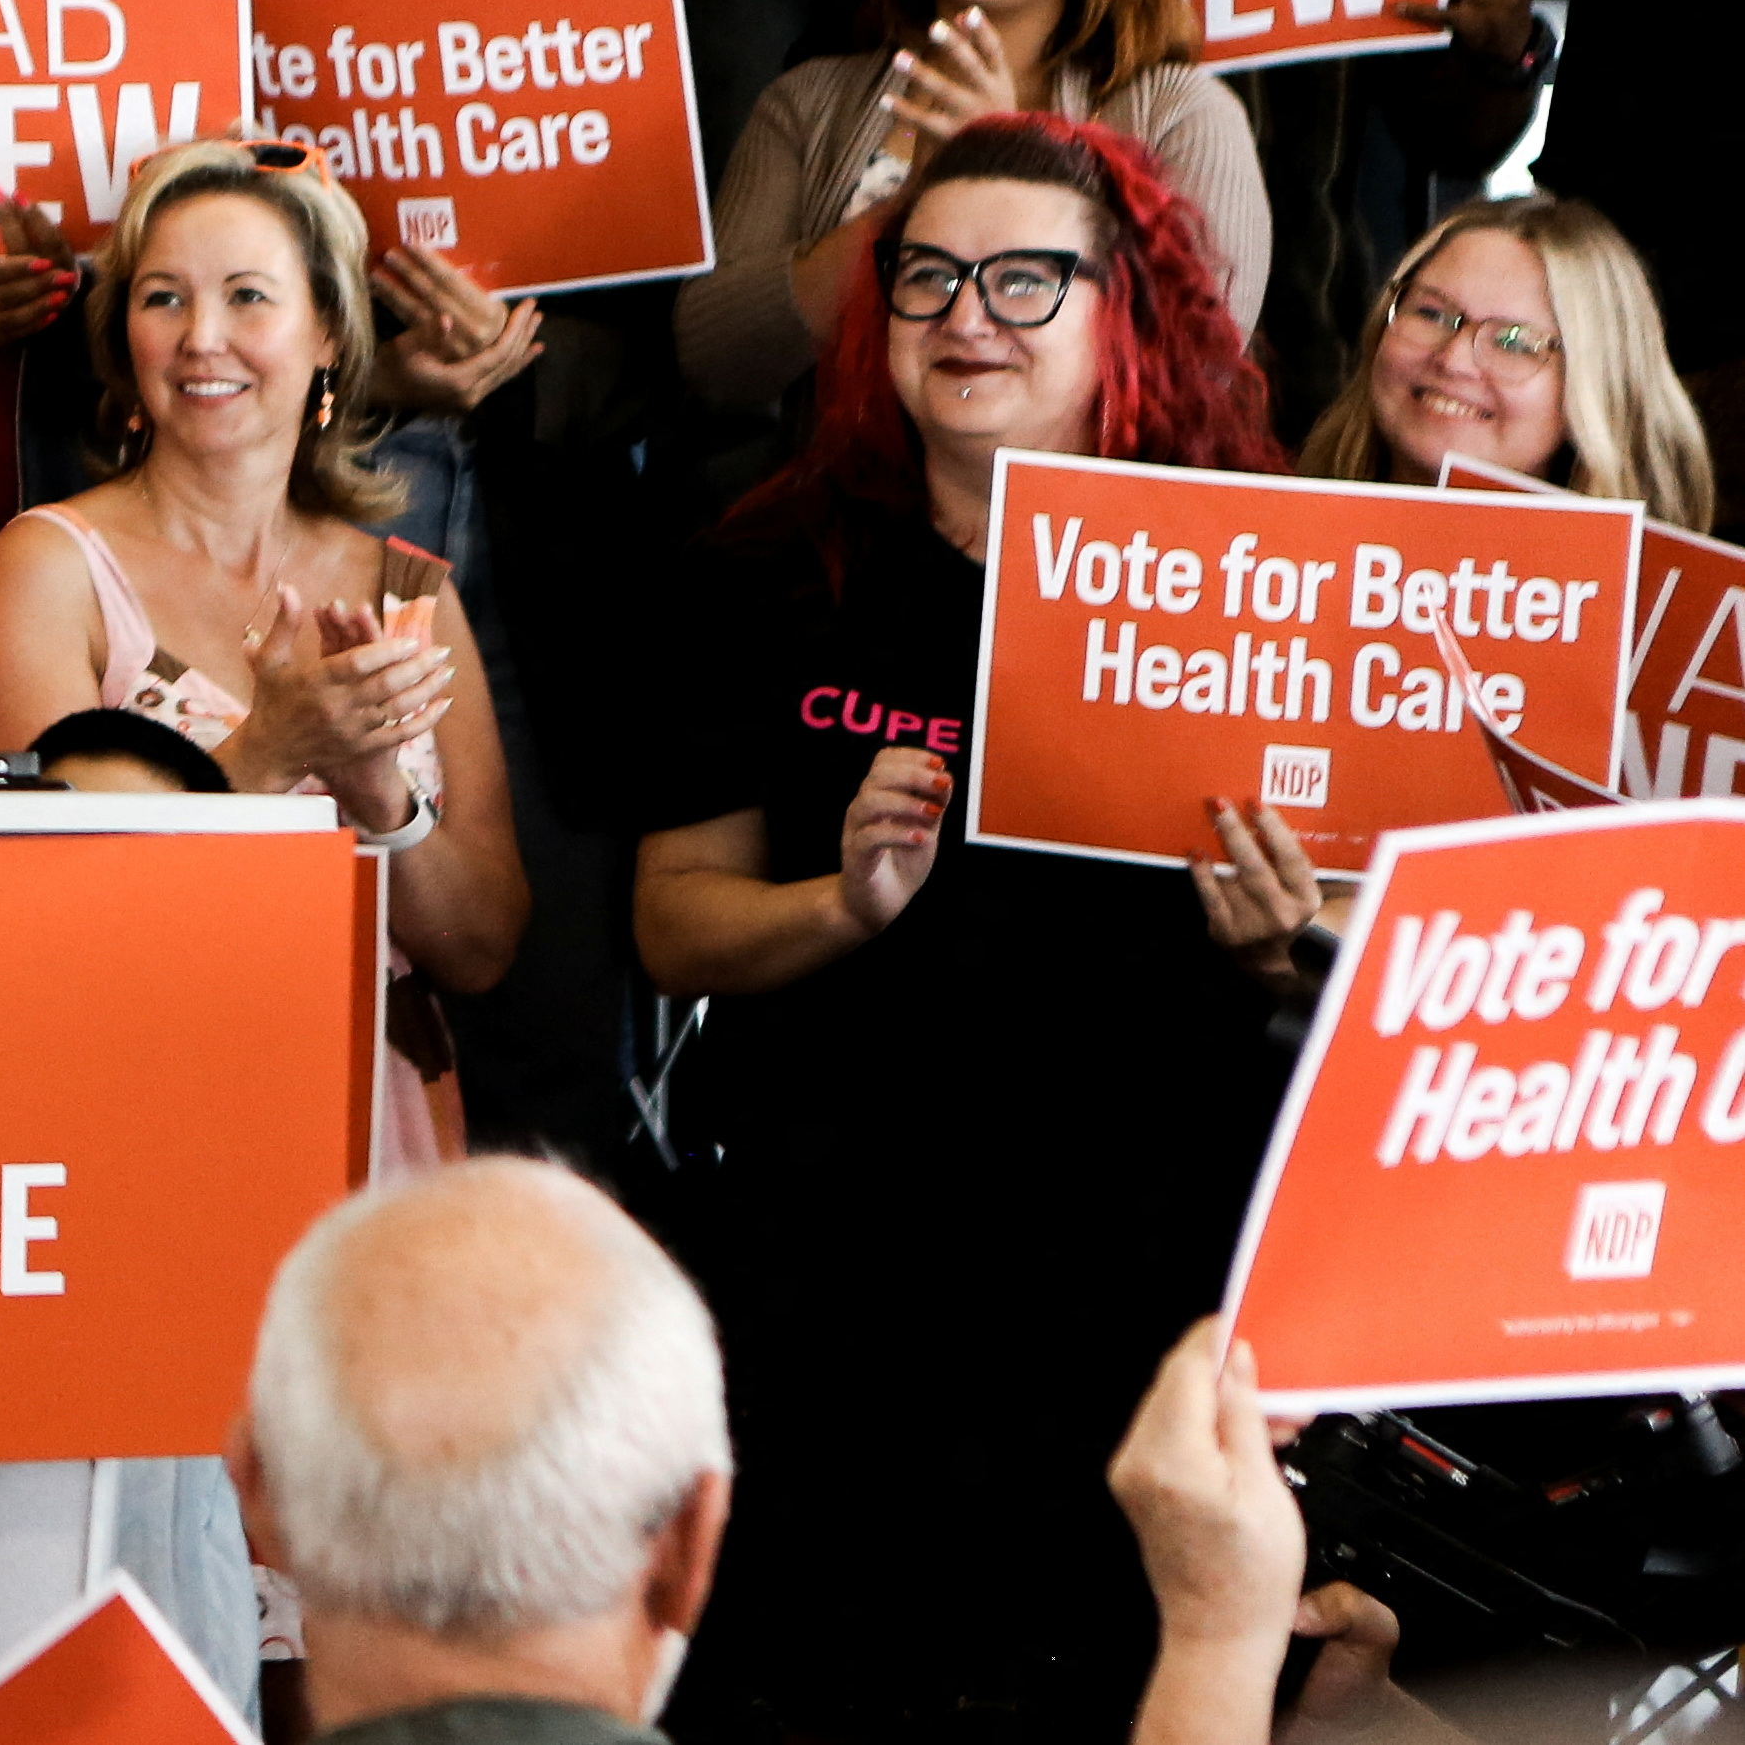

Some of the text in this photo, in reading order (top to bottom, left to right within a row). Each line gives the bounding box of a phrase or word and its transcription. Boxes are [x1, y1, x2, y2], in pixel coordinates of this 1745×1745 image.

[254, 19, 652, 99] te for Better
[262, 103, 610, 180] alth Care
[1033, 514, 1202, 613] Vote
[1220, 534, 1336, 623] for
[1350, 542, 1599, 644] Better
[1083, 619, 1525, 735] Health Care
[800, 685, 960, 753] CUPE
[1270, 762, 1321, 797] NDP
[1374, 886, 1745, 1037] Vote for
[1377, 1025, 1696, 1167] Health
[1586, 1210, 1656, 1264] NDP
